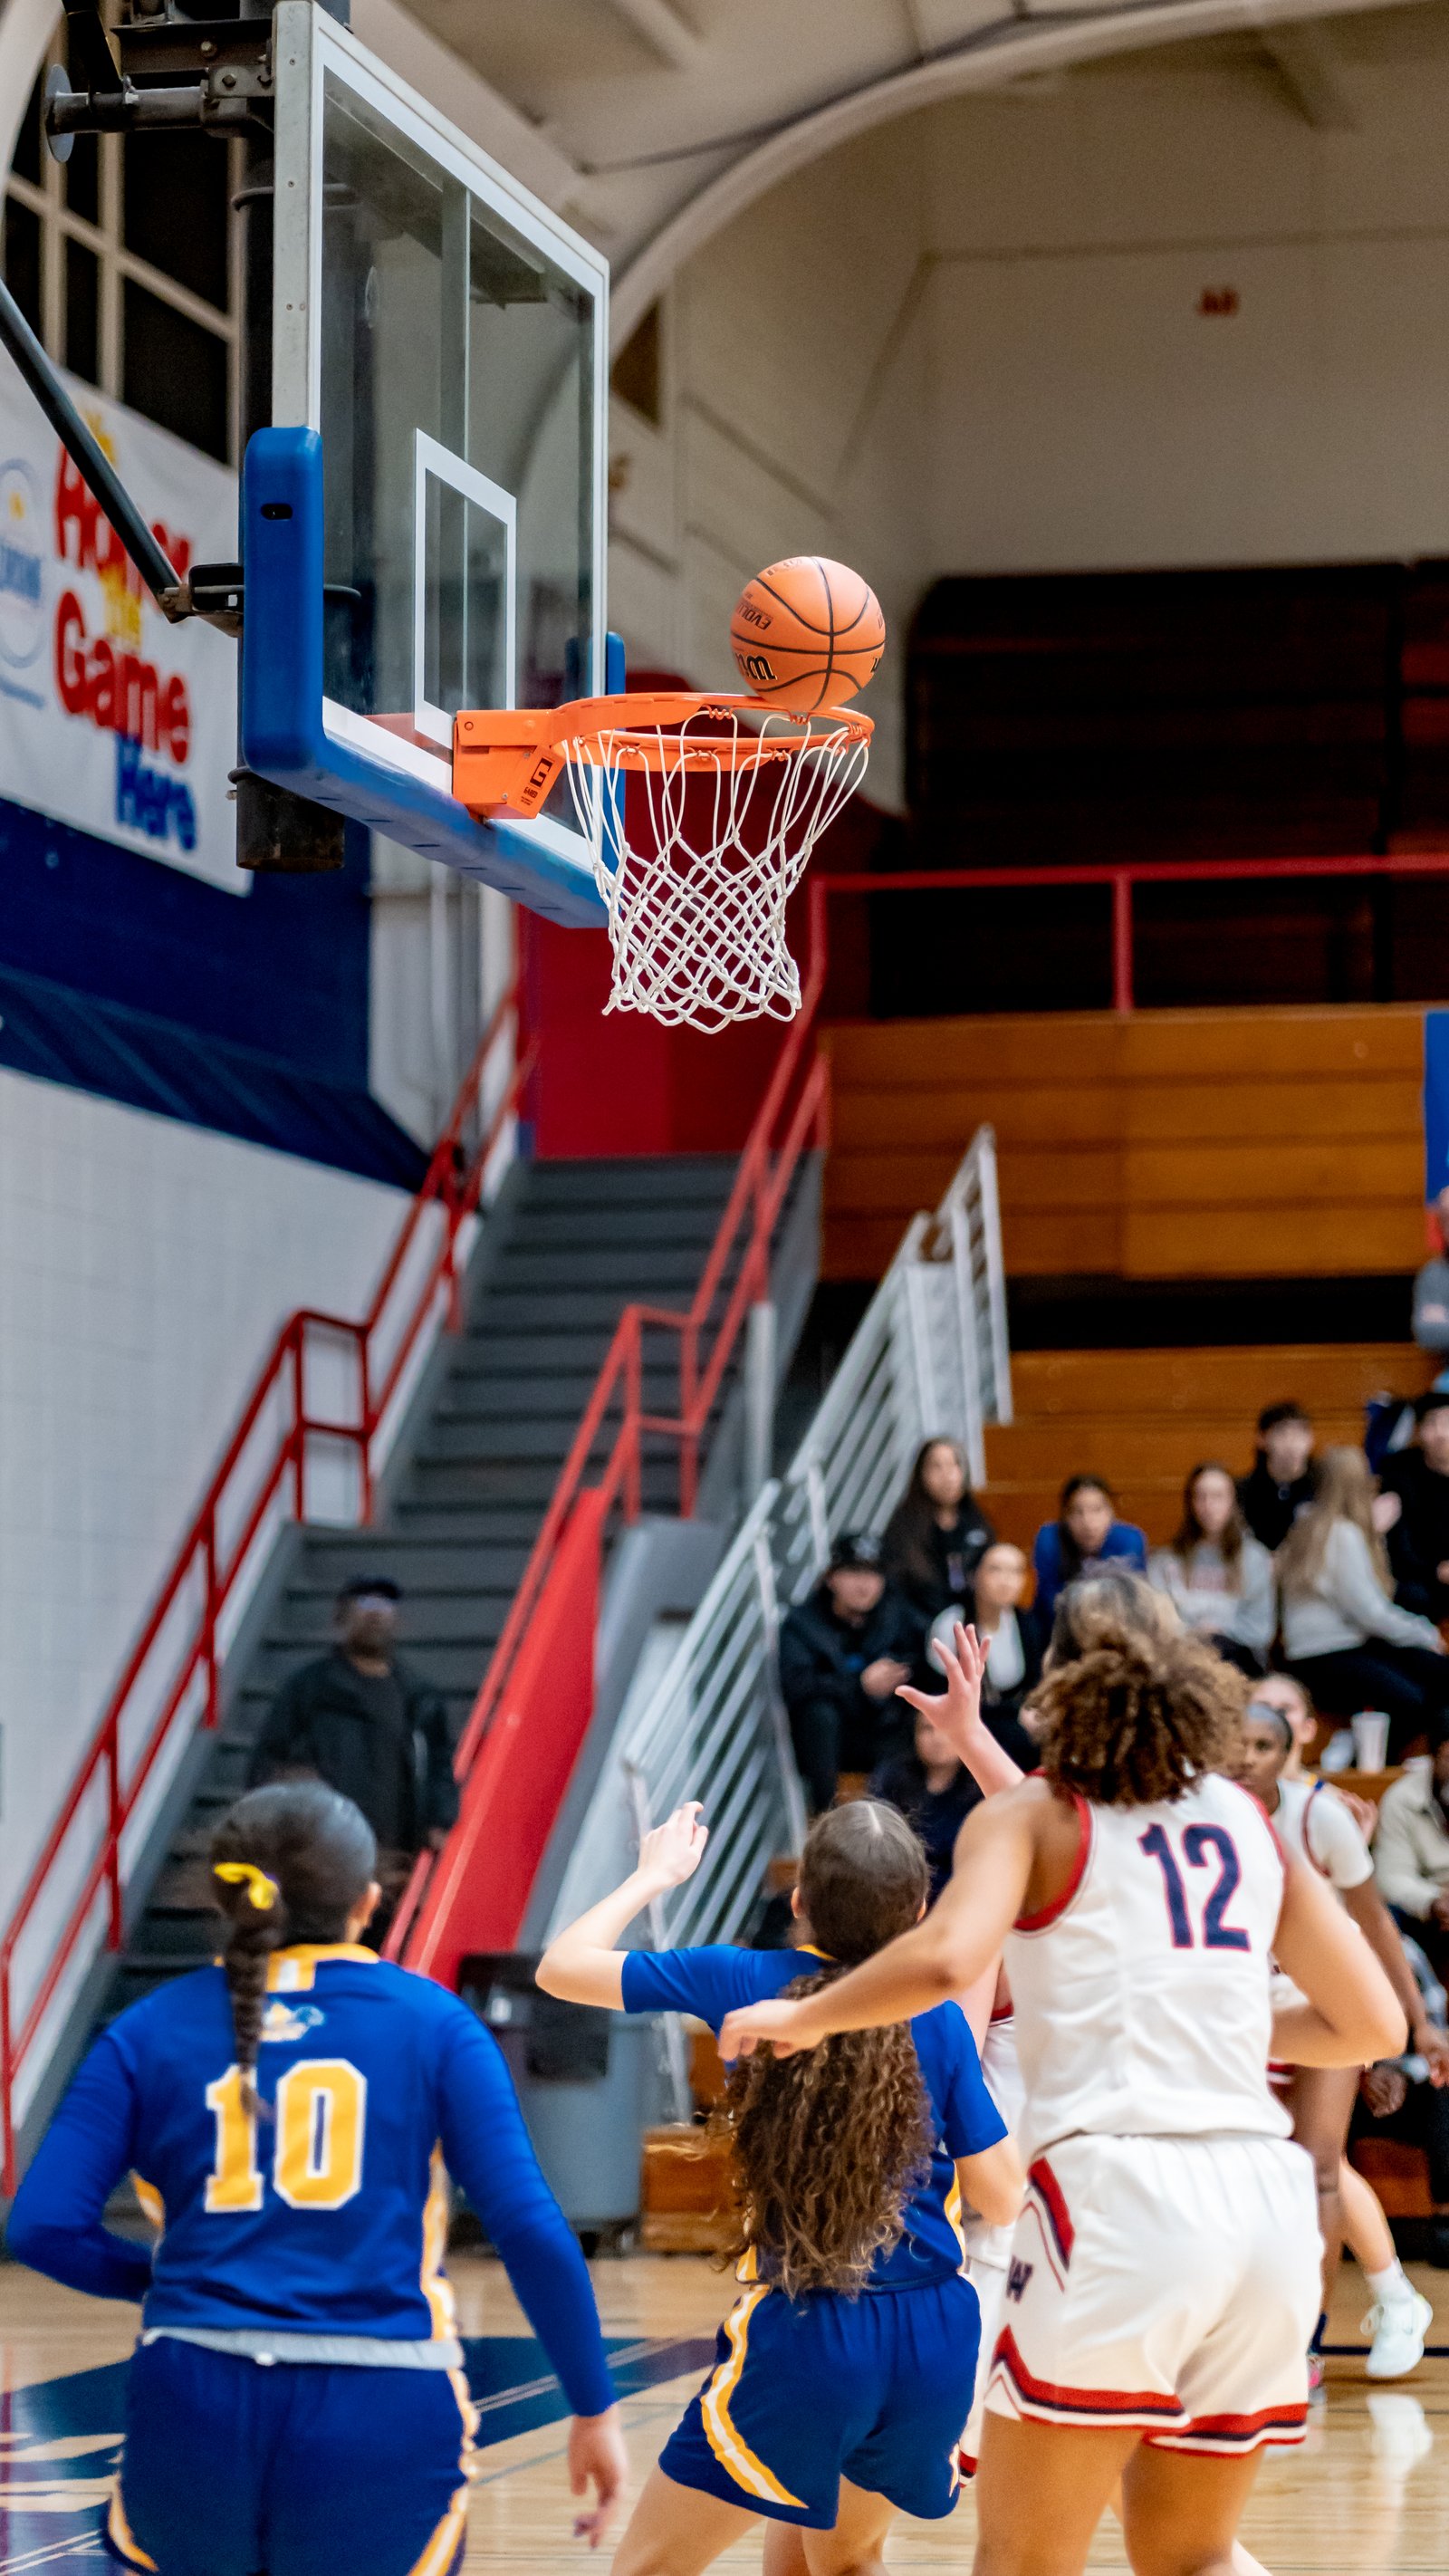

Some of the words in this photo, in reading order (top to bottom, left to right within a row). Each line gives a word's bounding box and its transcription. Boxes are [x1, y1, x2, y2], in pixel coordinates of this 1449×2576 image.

[54, 591, 190, 763] Game
[530, 757, 553, 788] G
[1137, 1821, 1252, 1953] 12
[204, 2058, 368, 2213] 10
